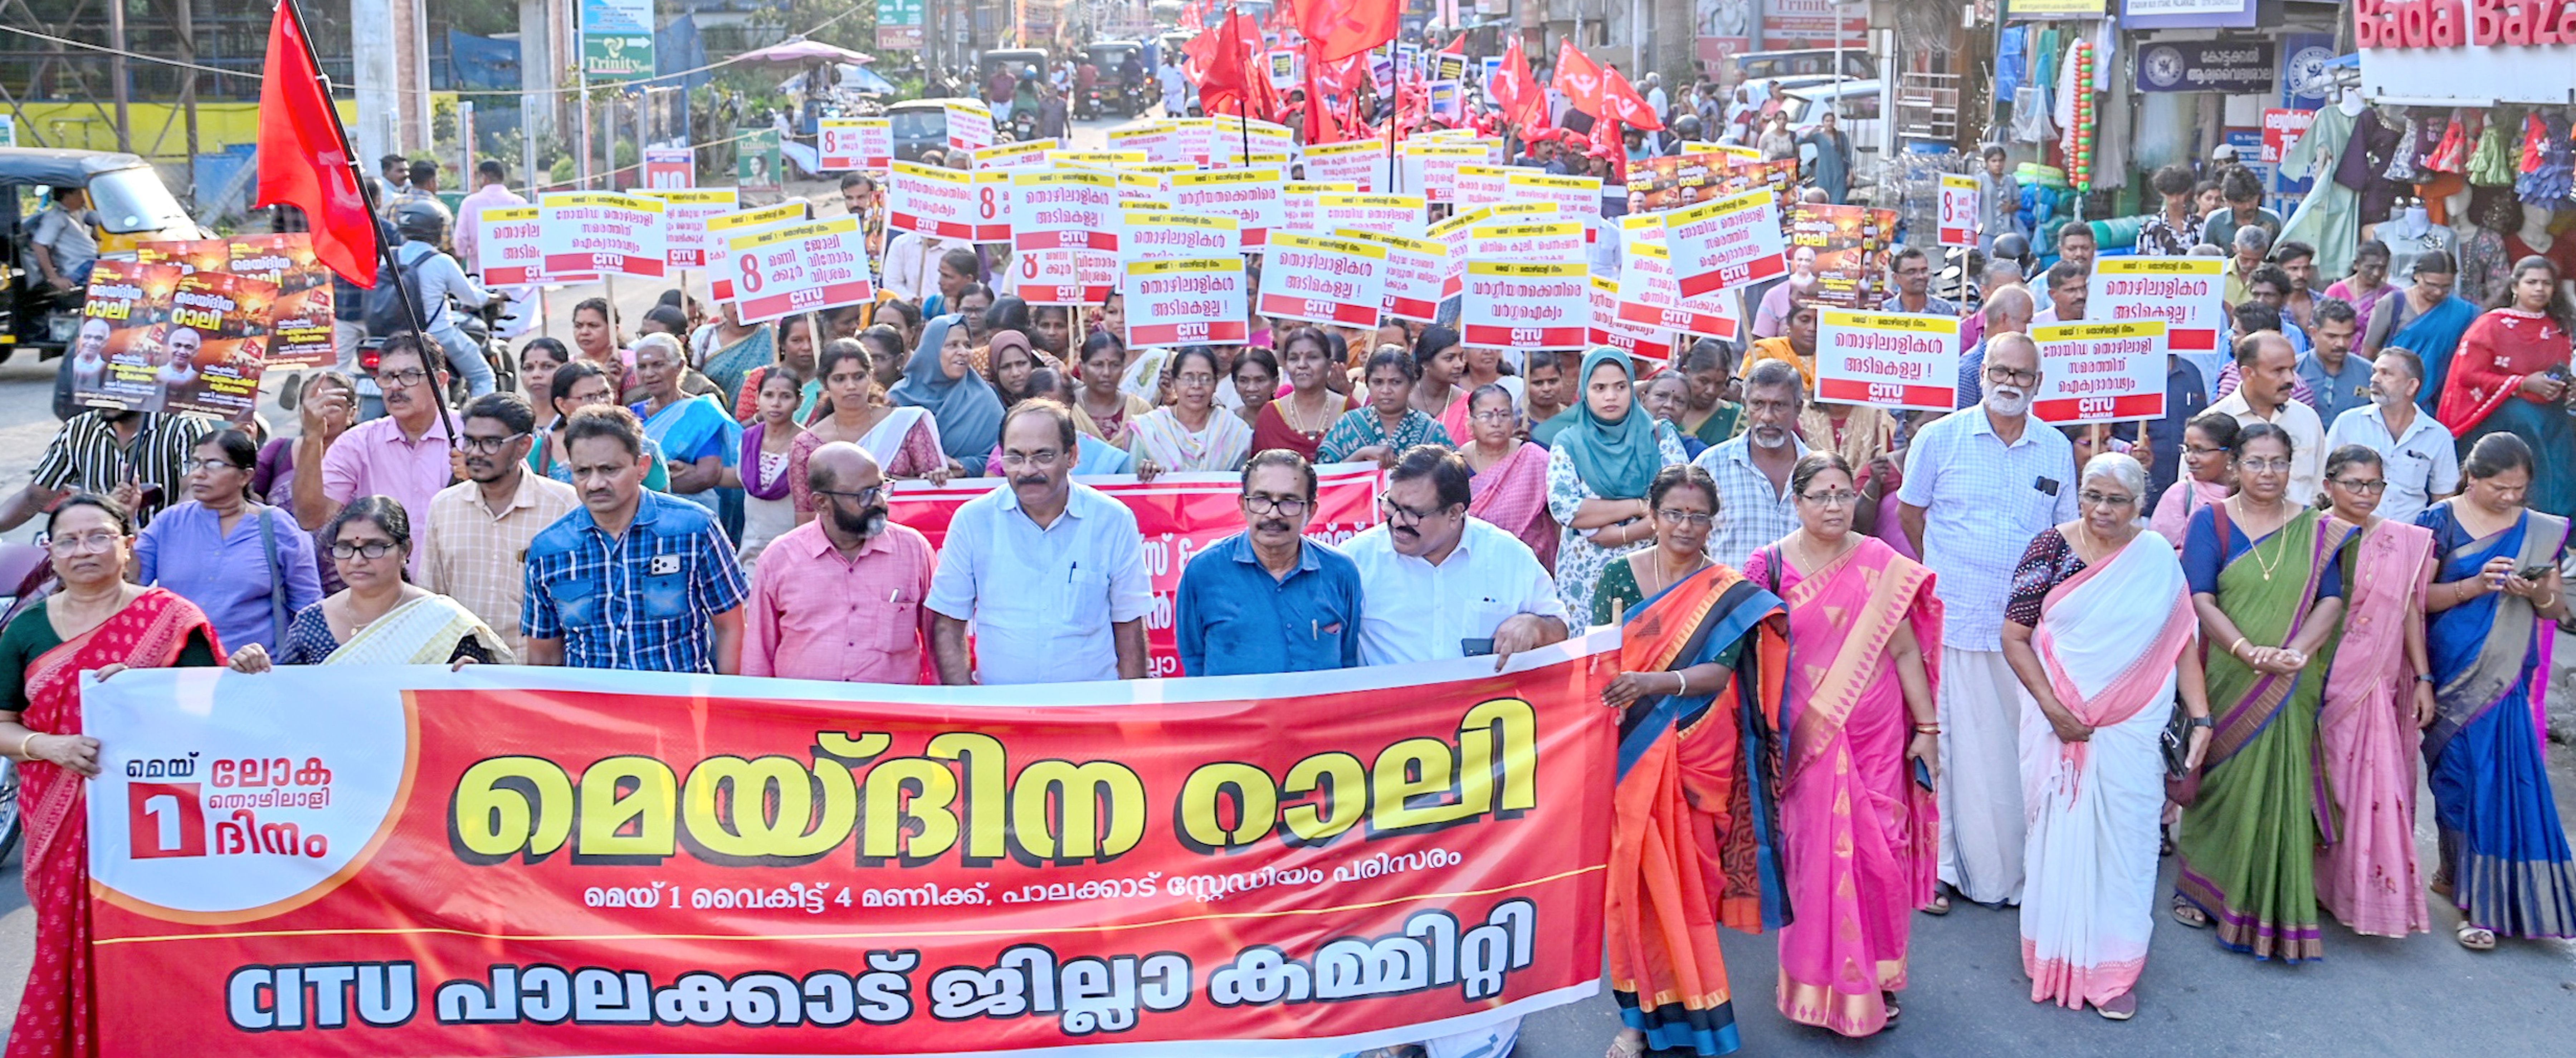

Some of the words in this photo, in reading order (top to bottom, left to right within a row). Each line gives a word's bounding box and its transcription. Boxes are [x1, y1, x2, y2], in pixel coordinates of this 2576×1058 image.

[2353, 0, 2466, 48] Bada
[586, 56, 640, 71] Trinity
[825, 131, 835, 153] 8
[2261, 144, 2278, 161] Rs.
[653, 171, 685, 188] NO
[980, 187, 995, 219] 8
[1026, 187, 1109, 205] തൊഴിലാളികൾ
[916, 217, 939, 231] CITU
[758, 233, 772, 242] മെയ്
[783, 226, 814, 237] തൊഴിലാളി
[1059, 230, 1088, 242] CITU
[1135, 229, 1225, 248] തൊഴിലാളികൾ
[1794, 232, 1828, 247] റാലി
[592, 252, 625, 266] CITU
[670, 248, 697, 260] CITU
[740, 254, 762, 293] 8
[1280, 253, 1372, 276] തൊഴിലാളികൾ
[1719, 263, 1751, 283] CITU
[2148, 262, 2179, 271] തൊഴിലാളി
[1141, 274, 1234, 294] തൊഴിലാളികൾ
[1284, 275, 1353, 300] അടിമകളല്ല
[2106, 278, 2207, 299] തൊഴിലാളികൾ
[789, 286, 824, 305] CITU
[85, 300, 131, 320] റാലി
[1152, 299, 1220, 317] അടിമകളല്ല
[1304, 298, 1337, 315] CITU
[171, 307, 223, 331] റാലി
[1660, 308, 1693, 325] CITU
[1878, 318, 1911, 328] തൊഴിലാളി
[1913, 319, 1926, 327] ദിനം
[1176, 322, 1208, 336] CITU
[1509, 327, 1543, 341] CITU
[2059, 327, 2074, 336] മെയ്
[2086, 325, 2119, 335] തൊഴിലാളി
[1606, 333, 1636, 349] CITU
[1836, 333, 1942, 355] തൊഴിലാളികൾ
[2044, 341, 2087, 358] നോയിഡ
[2093, 338, 2151, 355] തൊഴിലാളി
[1845, 356, 1921, 380] അടിമകളല്ല
[2069, 357, 2126, 373] സമരത്തിന്
[1869, 382, 1905, 397] CITU
[2059, 377, 2135, 394] ഐക്യദാർഢ്യം
[1867, 395, 1903, 405] PALAKKAD
[2078, 396, 2114, 412] CITU
[2078, 412, 2114, 420] PALAKKAD
[127, 751, 199, 778] മെയ്
[211, 756, 332, 788] ലോക
[448, 730, 1146, 867] മെയ്ദിന
[1174, 697, 1537, 854] റാലി
[145, 794, 181, 851] 1
[208, 787, 330, 810] തൊഴിലാളി
[215, 809, 328, 858] ദിനം
[584, 880, 666, 910] മെയ്
[670, 886, 681, 908] 1
[691, 881, 826, 913] വൈകീട്ട്
[834, 886, 852, 908] 4
[1002, 870, 1163, 904] പാലക്കാട്
[1166, 863, 1323, 904] സ്റ്റേഡിയം
[1333, 846, 1461, 883] പരിസരം
[226, 959, 417, 1031] CITU
[434, 949, 920, 1029] പാലക്കാട്
[926, 941, 1193, 1037] ജില്ലാ
[1209, 896, 1537, 1007] കമ്മിറ്റി
